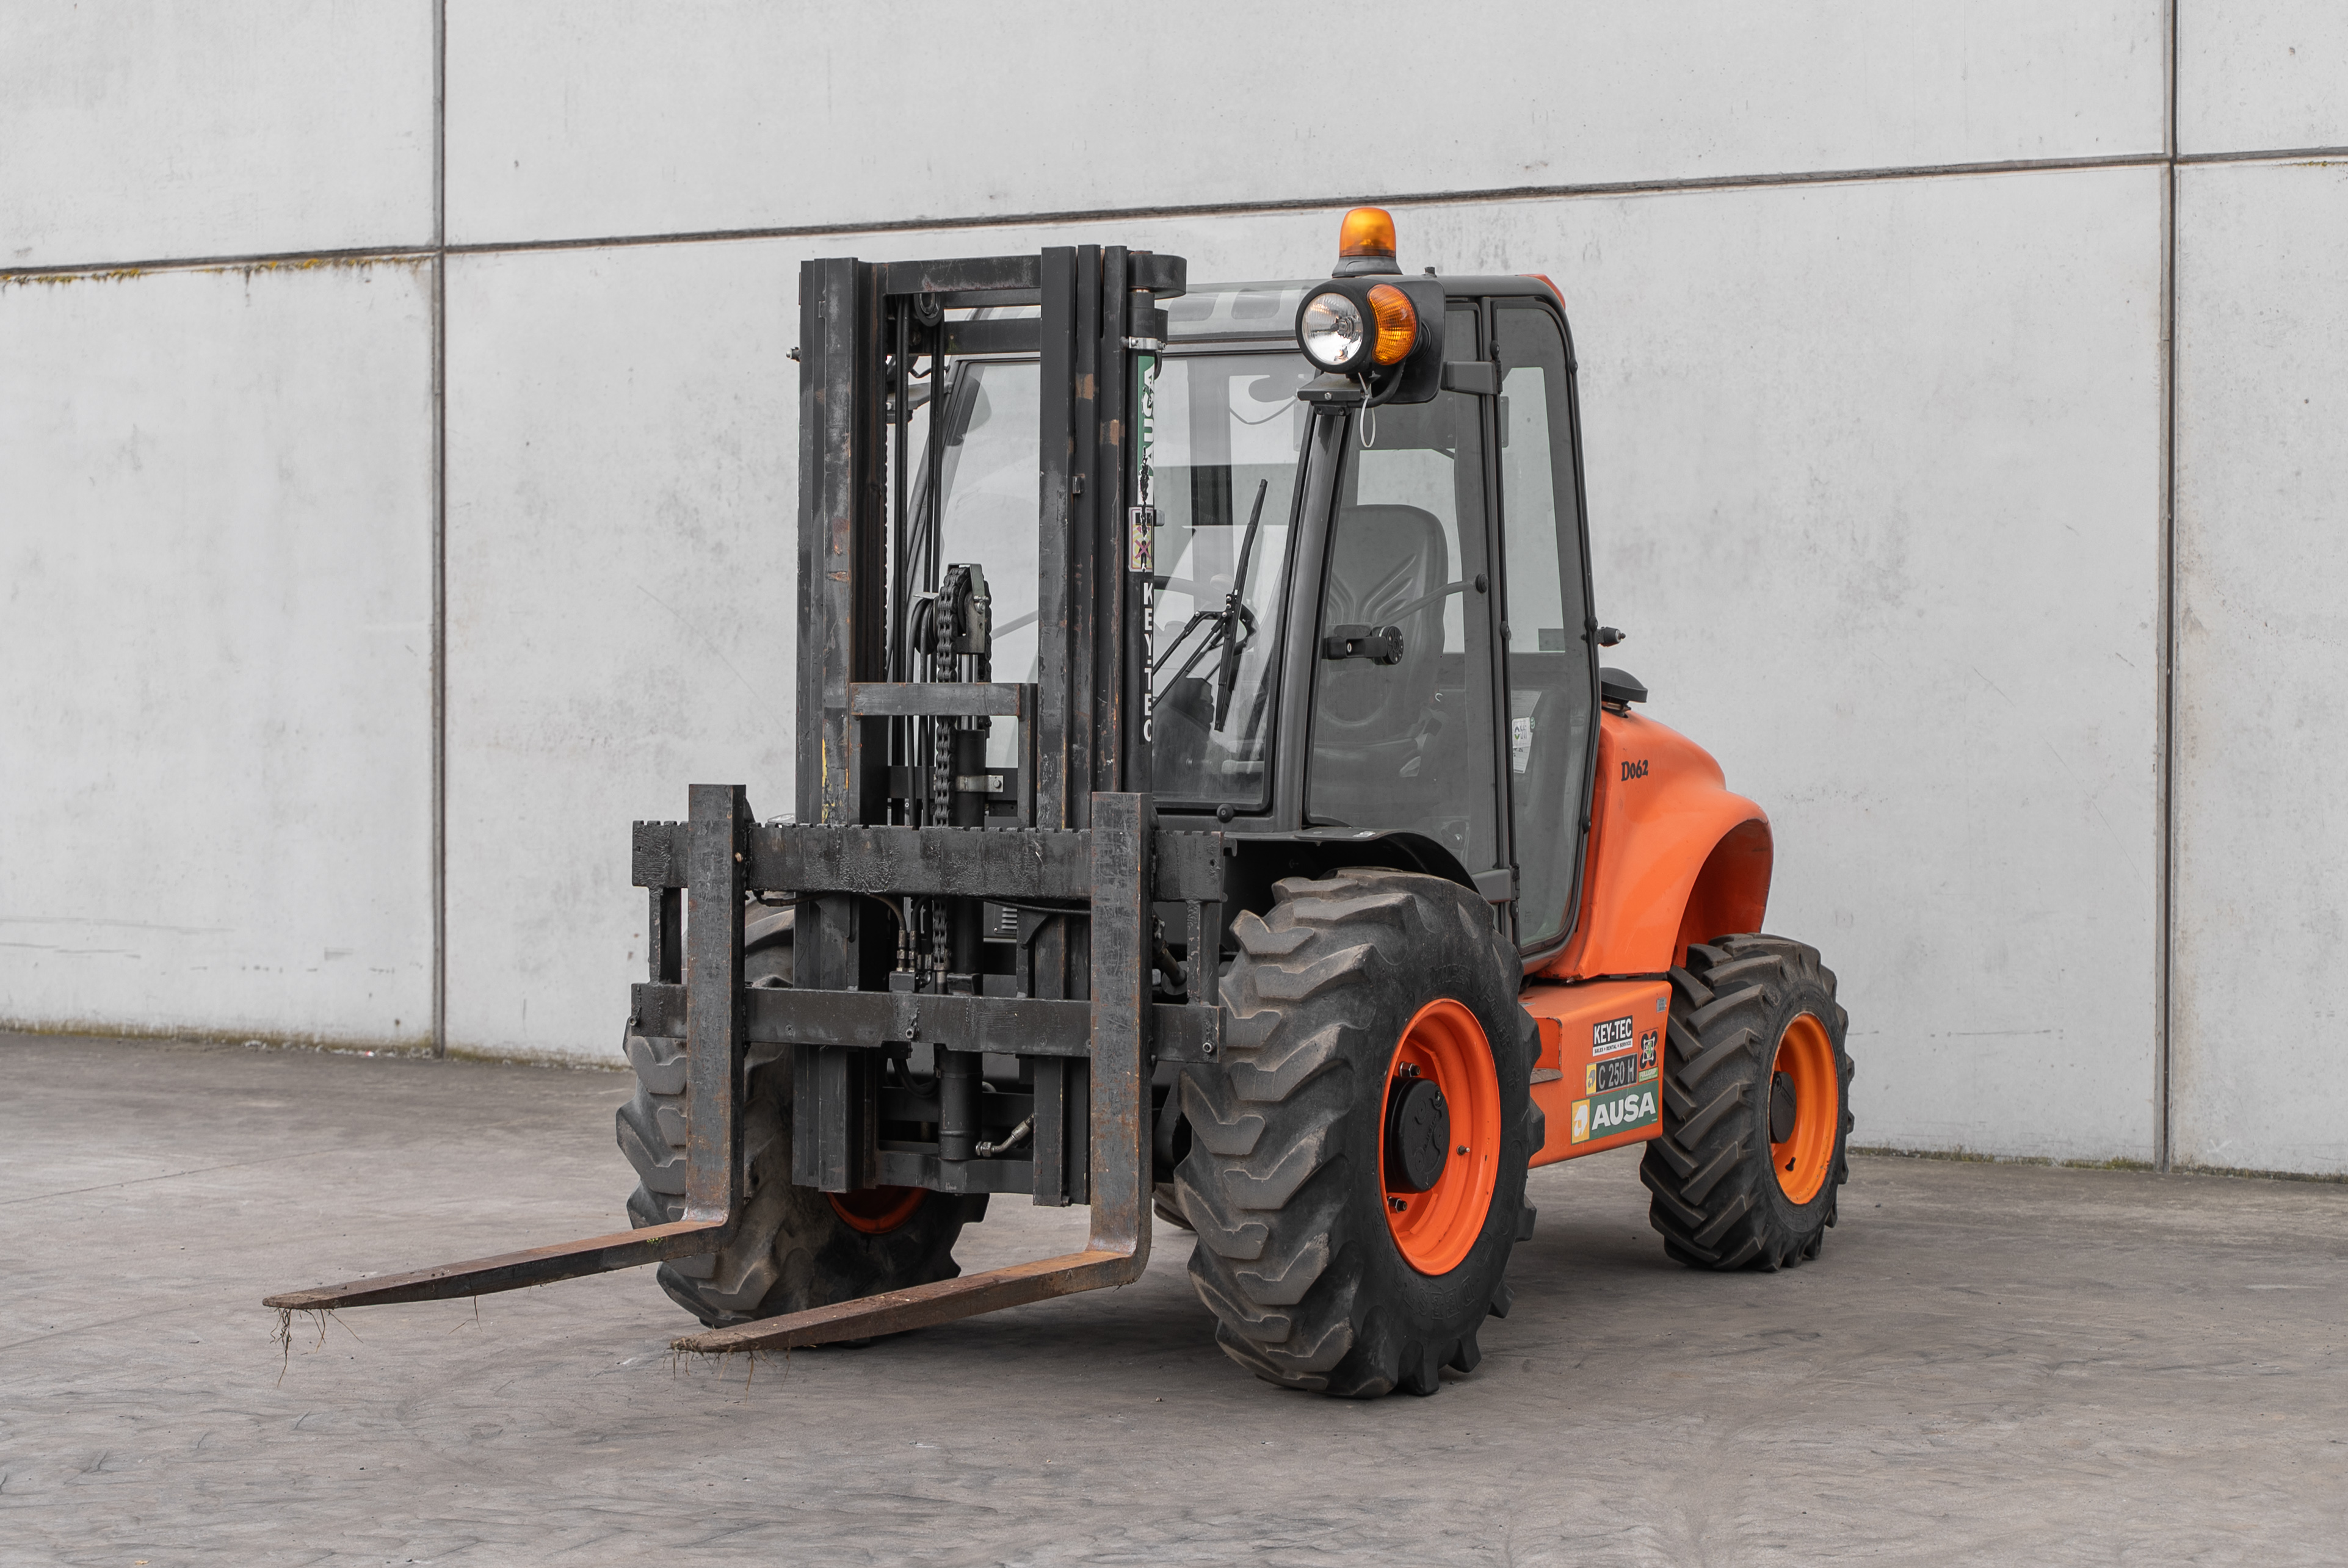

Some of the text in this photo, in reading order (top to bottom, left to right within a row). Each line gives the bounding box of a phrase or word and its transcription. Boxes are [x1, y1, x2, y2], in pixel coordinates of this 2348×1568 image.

[1594, 1018, 1632, 1045] KEY-TEC
[1599, 1058, 1634, 1089] C 250 H
[1592, 1092, 1656, 1130] AUSA
